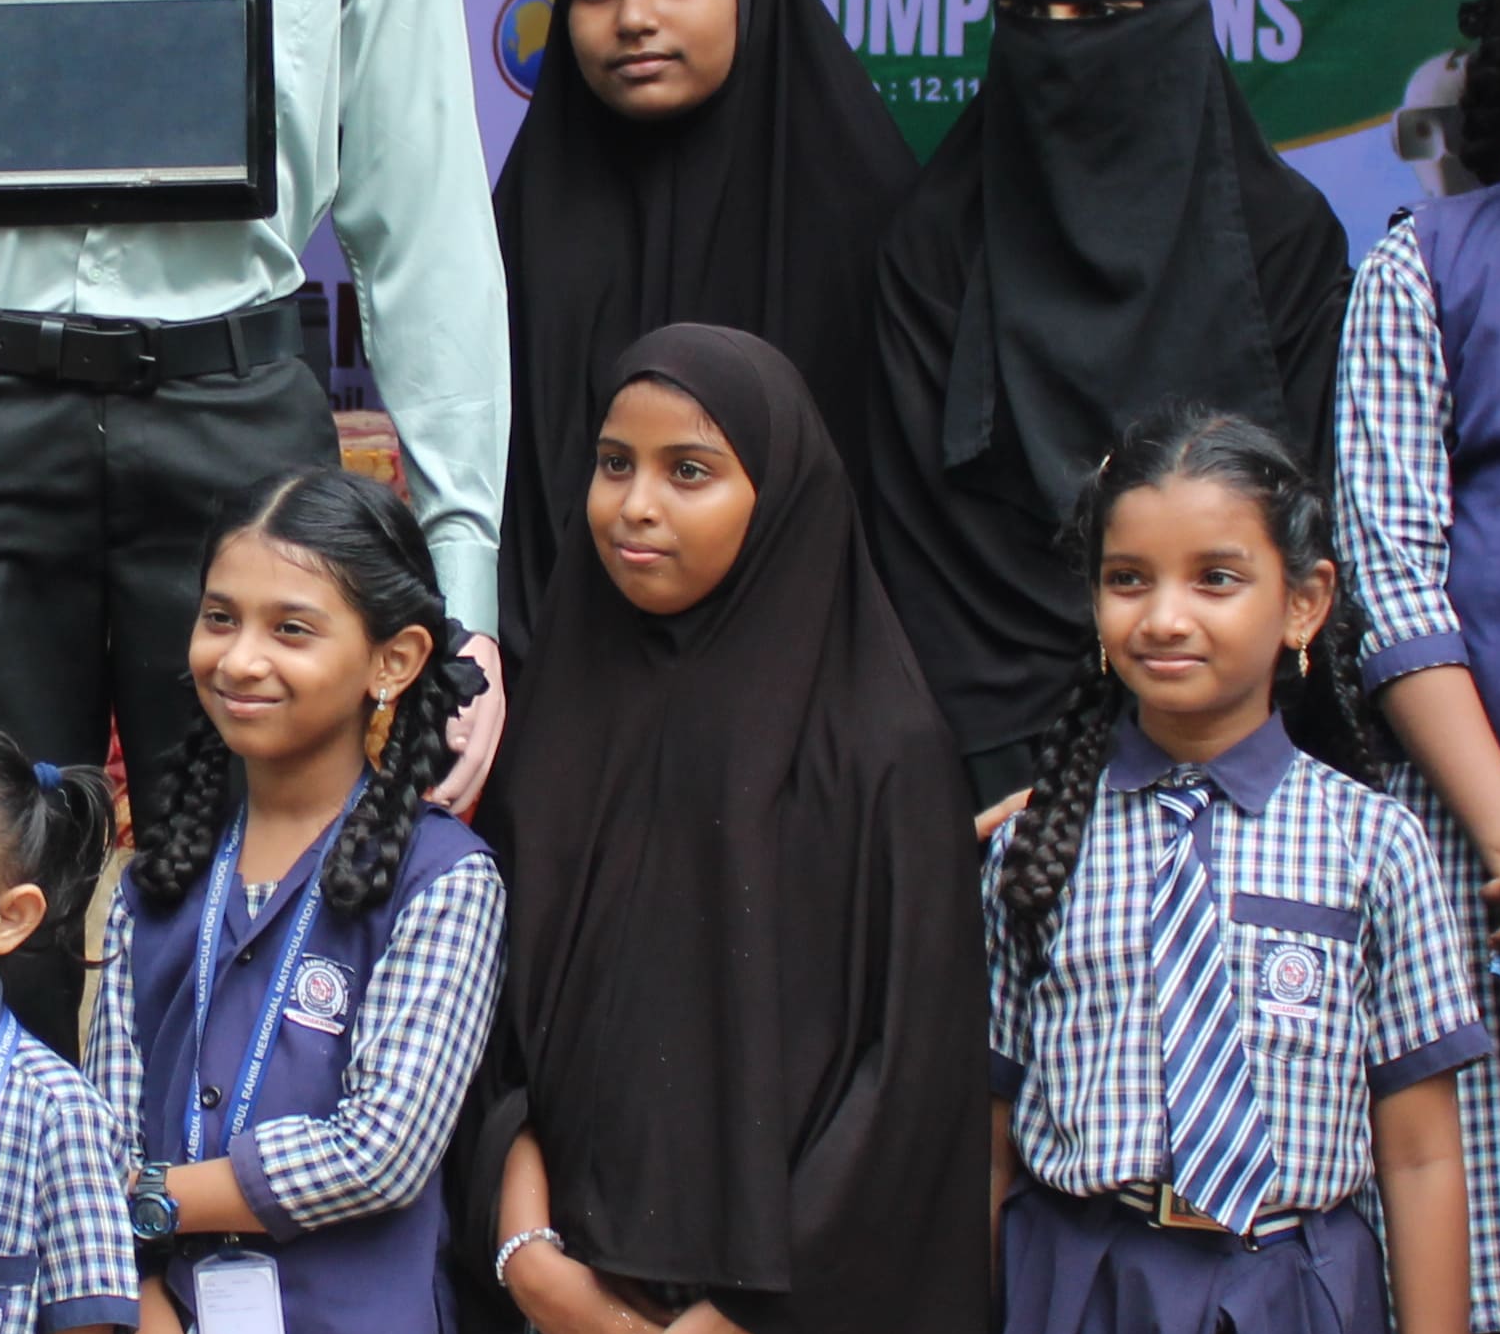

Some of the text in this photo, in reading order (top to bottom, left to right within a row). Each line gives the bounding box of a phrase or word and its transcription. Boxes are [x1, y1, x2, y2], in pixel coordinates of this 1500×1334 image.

[212, 859, 229, 906] SCHOOL
[242, 1059, 263, 1101] RAHIM
[254, 995, 283, 1060] MEMORIAL
[275, 898, 318, 995] MATRICULATION
[187, 1110, 202, 1157] ABDUL
